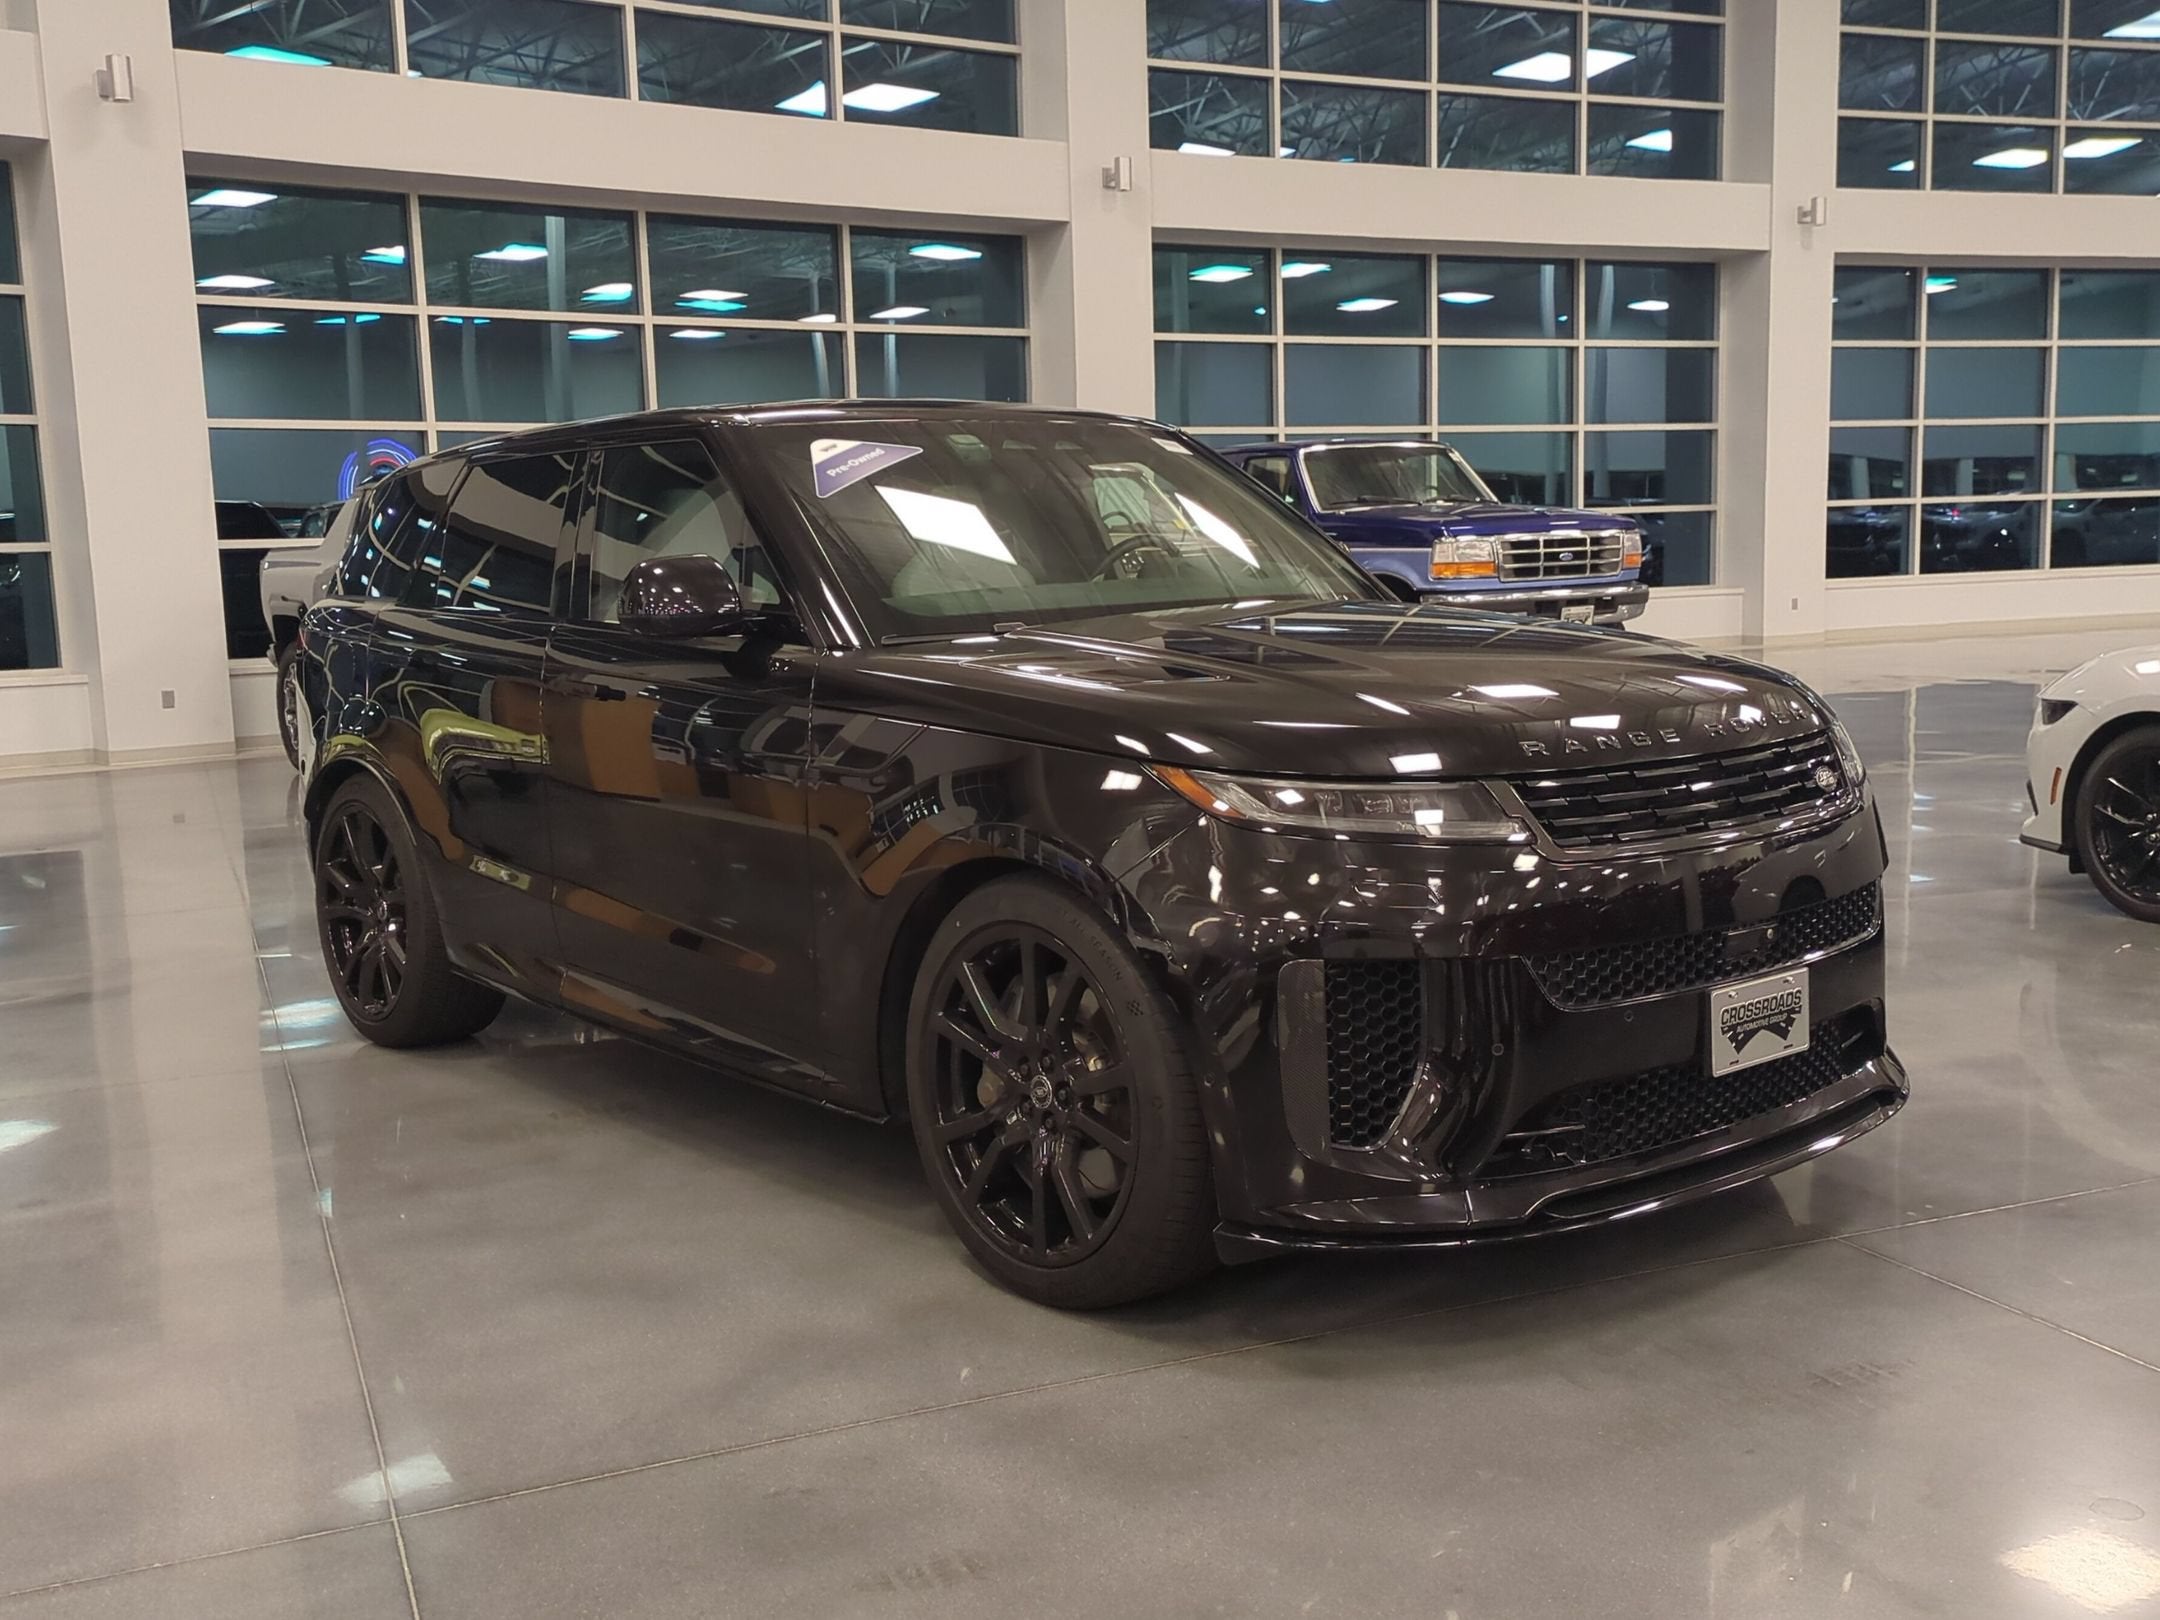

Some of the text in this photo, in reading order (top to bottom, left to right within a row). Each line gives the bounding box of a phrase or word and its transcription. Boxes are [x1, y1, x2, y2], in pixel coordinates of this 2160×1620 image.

[826, 448, 885, 477] Pre-Owned
[1519, 700, 1807, 756] RANGE ROVER
[1720, 987, 1802, 1026] CROSSROADS
